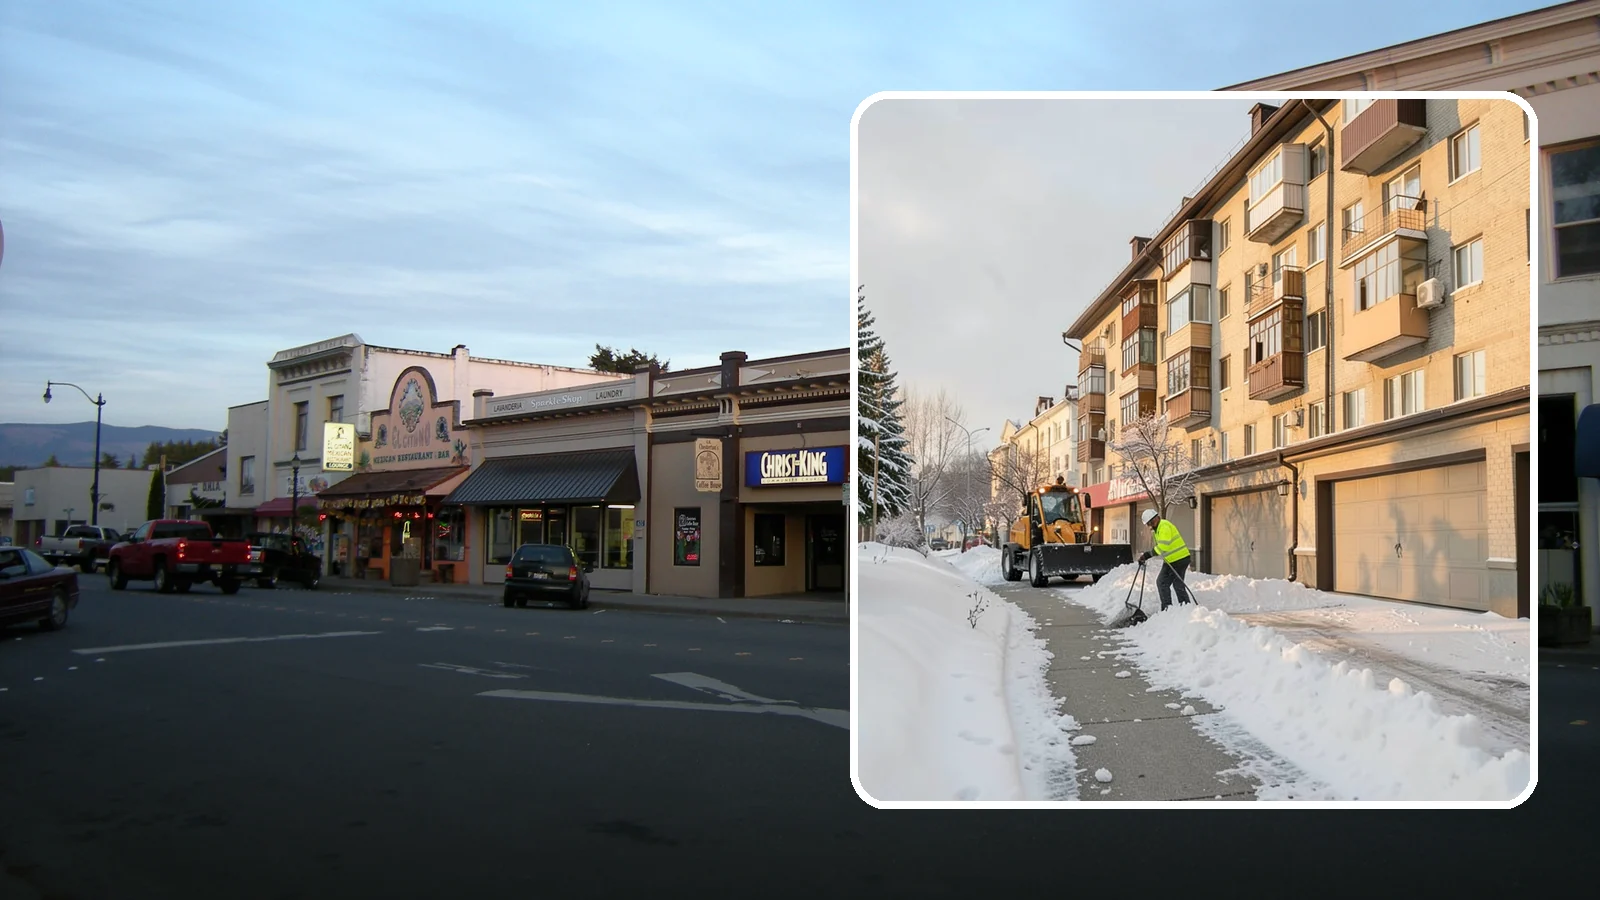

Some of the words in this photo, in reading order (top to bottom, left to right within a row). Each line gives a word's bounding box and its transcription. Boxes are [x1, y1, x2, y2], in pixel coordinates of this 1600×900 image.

[531, 398, 561, 408] Sparkle
[562, 394, 582, 404] Shop
[595, 389, 623, 400] LAUNDRY
[493, 402, 523, 413] LAVANDERIA
[392, 426, 401, 449] EL
[373, 455, 396, 465] MEXICAN
[397, 451, 433, 462] RESTAURANT
[438, 450, 450, 459] BAR
[799, 449, 828, 477] KING
[697, 481, 709, 489] Coffee
[710, 481, 722, 489] House
